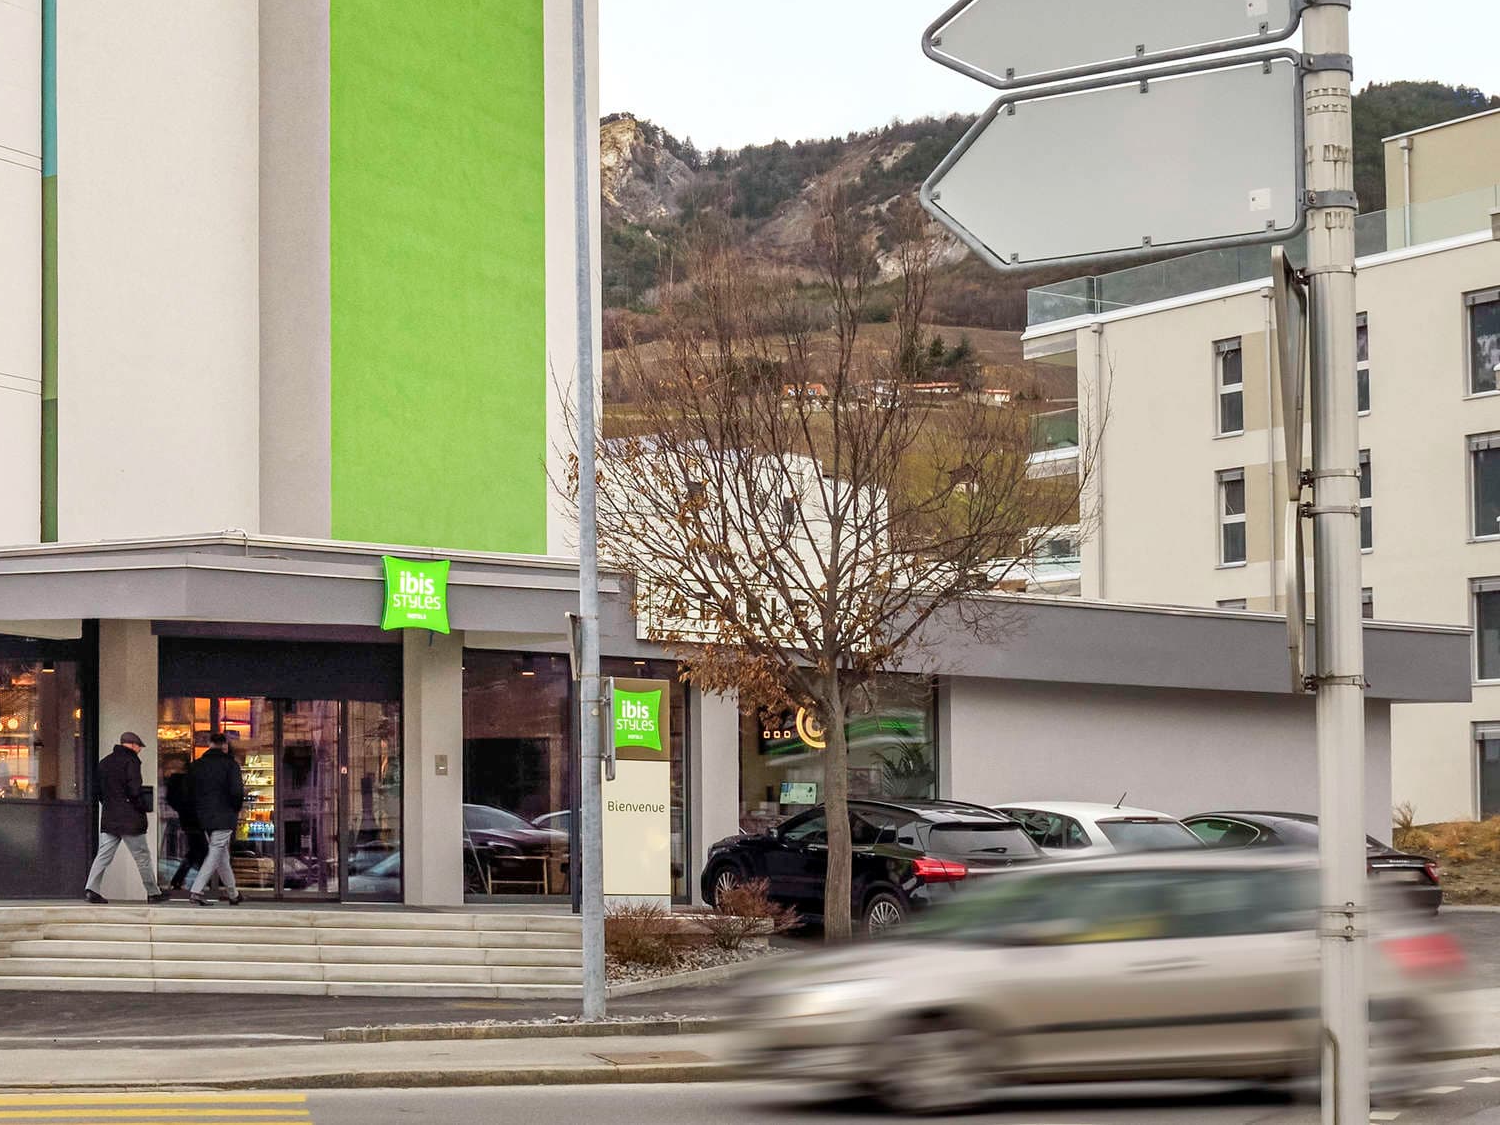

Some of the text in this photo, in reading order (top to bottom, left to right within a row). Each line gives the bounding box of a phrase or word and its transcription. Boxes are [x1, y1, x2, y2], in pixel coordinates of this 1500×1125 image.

[400, 570, 435, 595] ibis
[621, 700, 649, 719] ibis
[607, 800, 665, 813] Bienvenue
